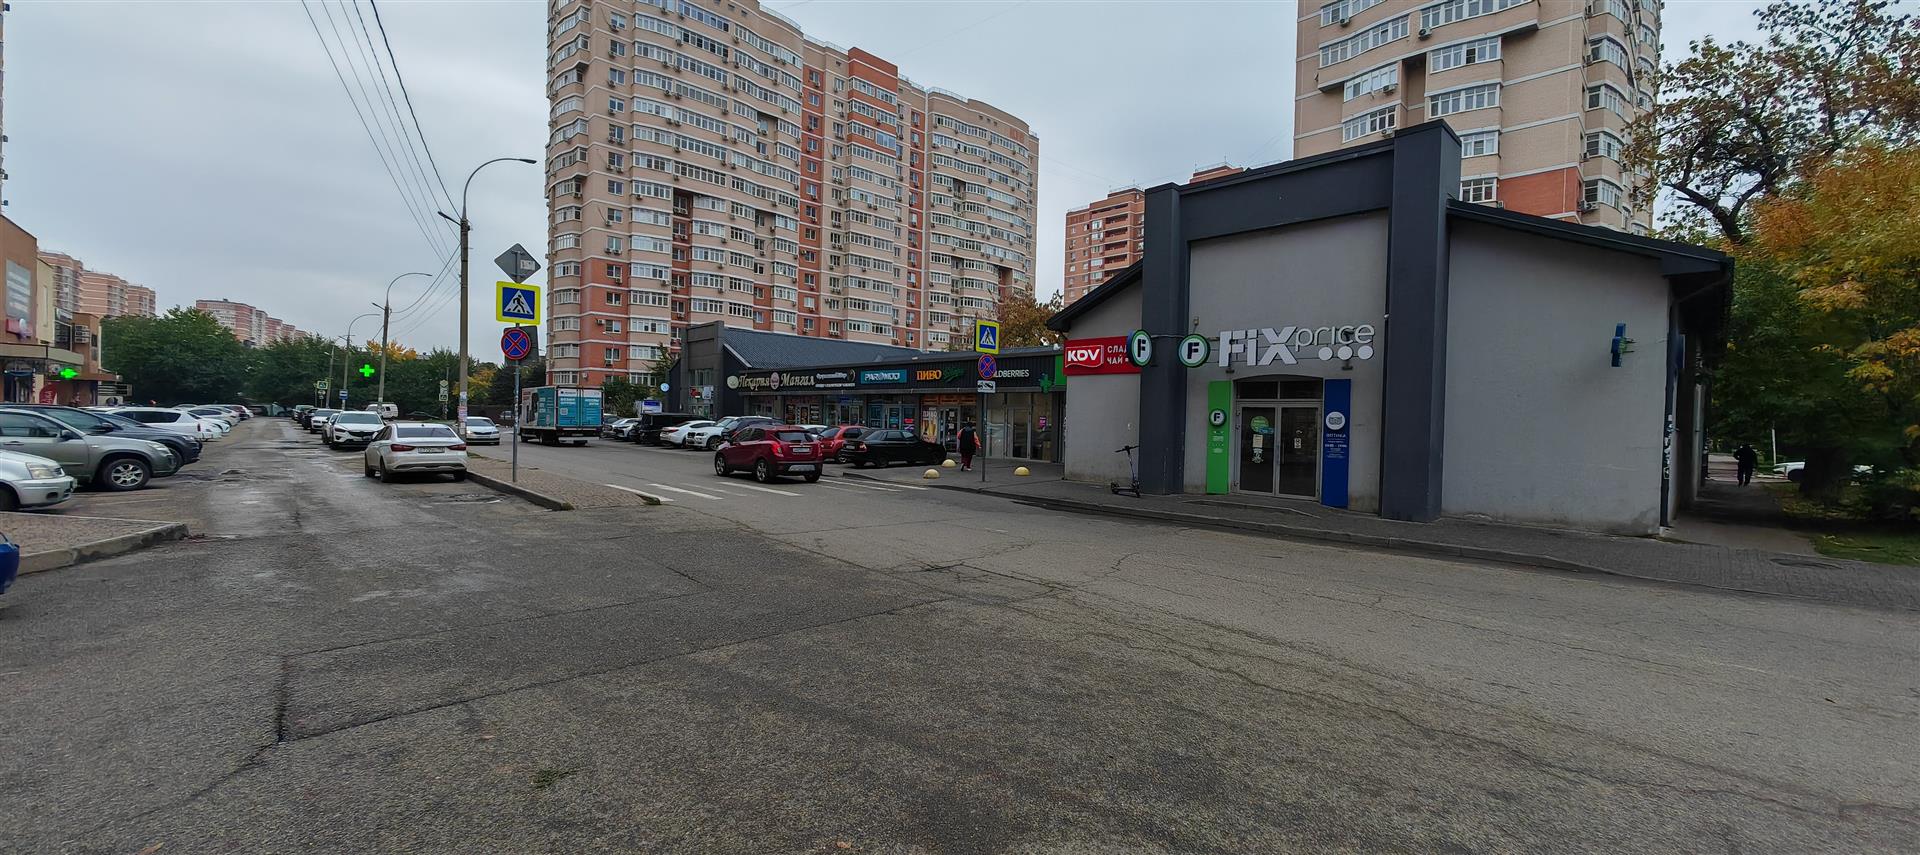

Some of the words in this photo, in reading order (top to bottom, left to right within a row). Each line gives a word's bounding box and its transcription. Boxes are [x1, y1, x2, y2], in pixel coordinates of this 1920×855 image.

[1295, 324, 1375, 352] price
[1067, 348, 1100, 362] KDV
[1107, 354, 1123, 364] ЧАЙ
[780, 373, 815, 387] Мангал
[916, 369, 942, 381] ПИВО
[994, 369, 1030, 378] LDBERRIES
